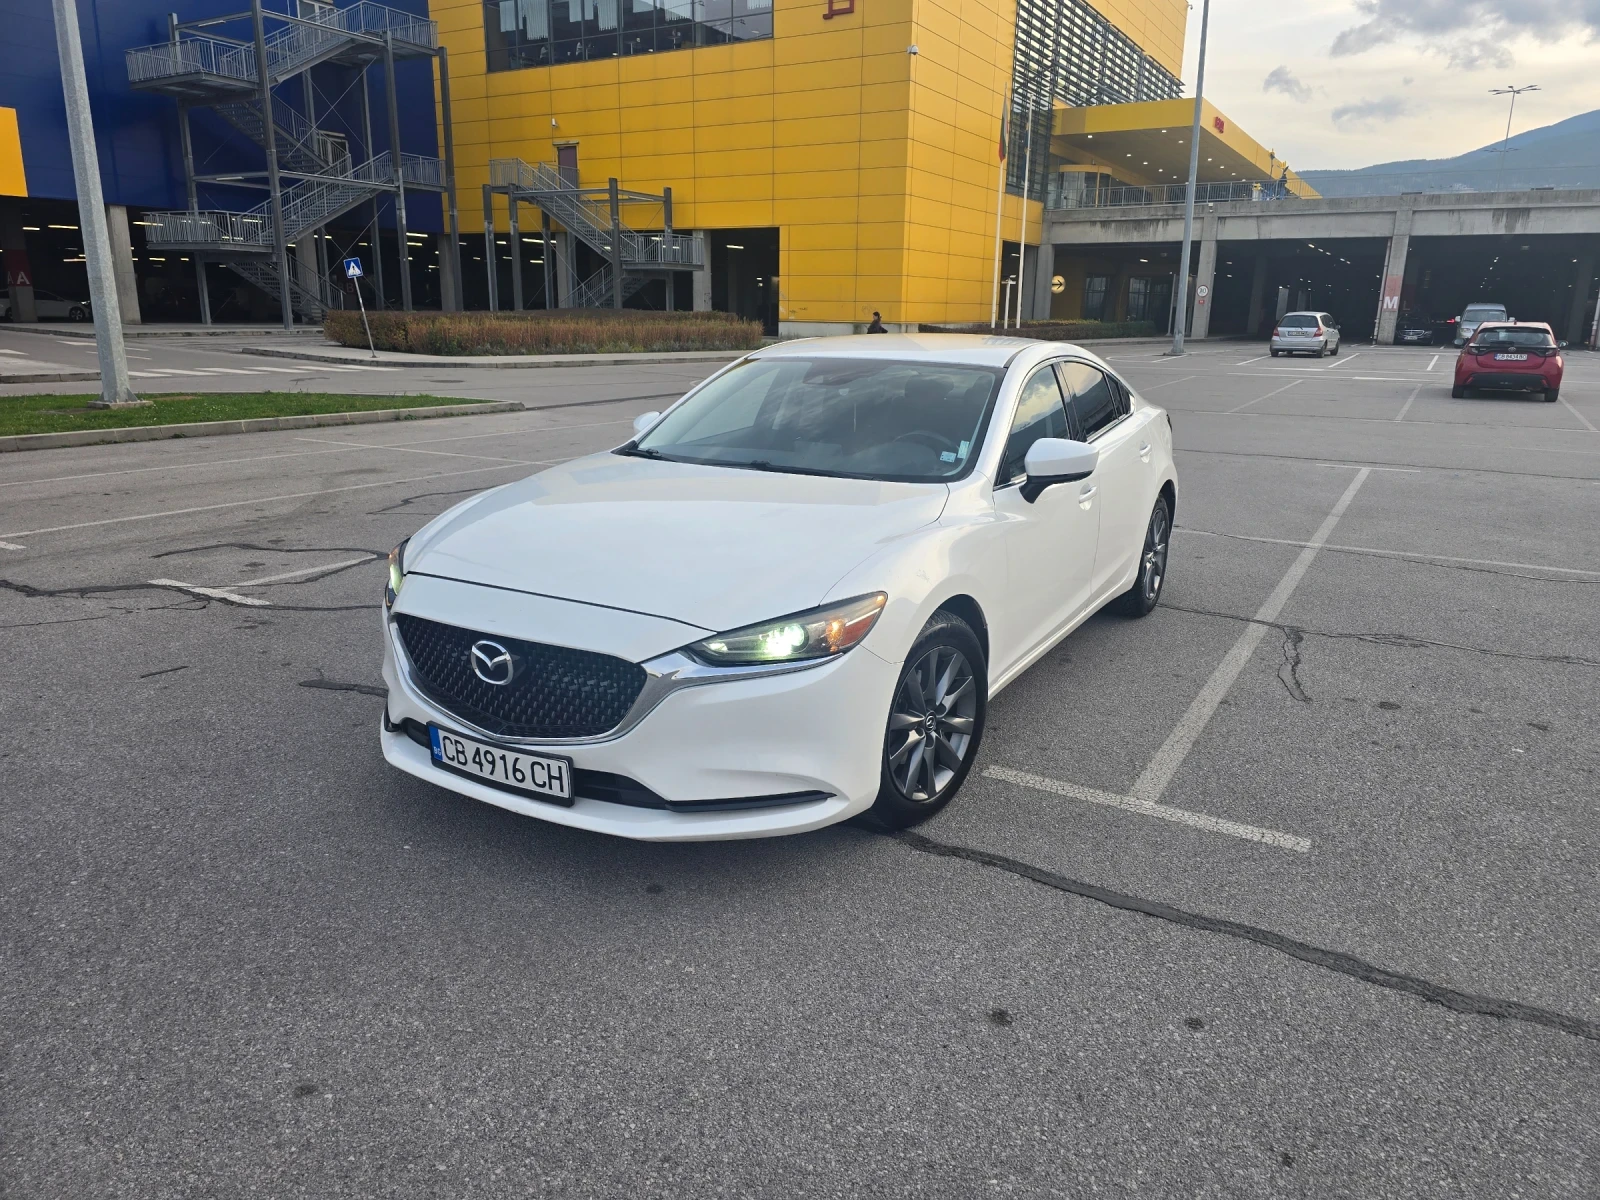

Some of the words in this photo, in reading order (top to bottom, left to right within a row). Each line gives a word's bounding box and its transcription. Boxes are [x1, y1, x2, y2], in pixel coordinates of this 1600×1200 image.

[16, 271, 30, 284] A
[1383, 296, 1399, 309] M
[433, 746, 442, 756] BG
[442, 736, 468, 766] CB
[472, 747, 526, 783] 4916
[530, 761, 564, 793] CH
